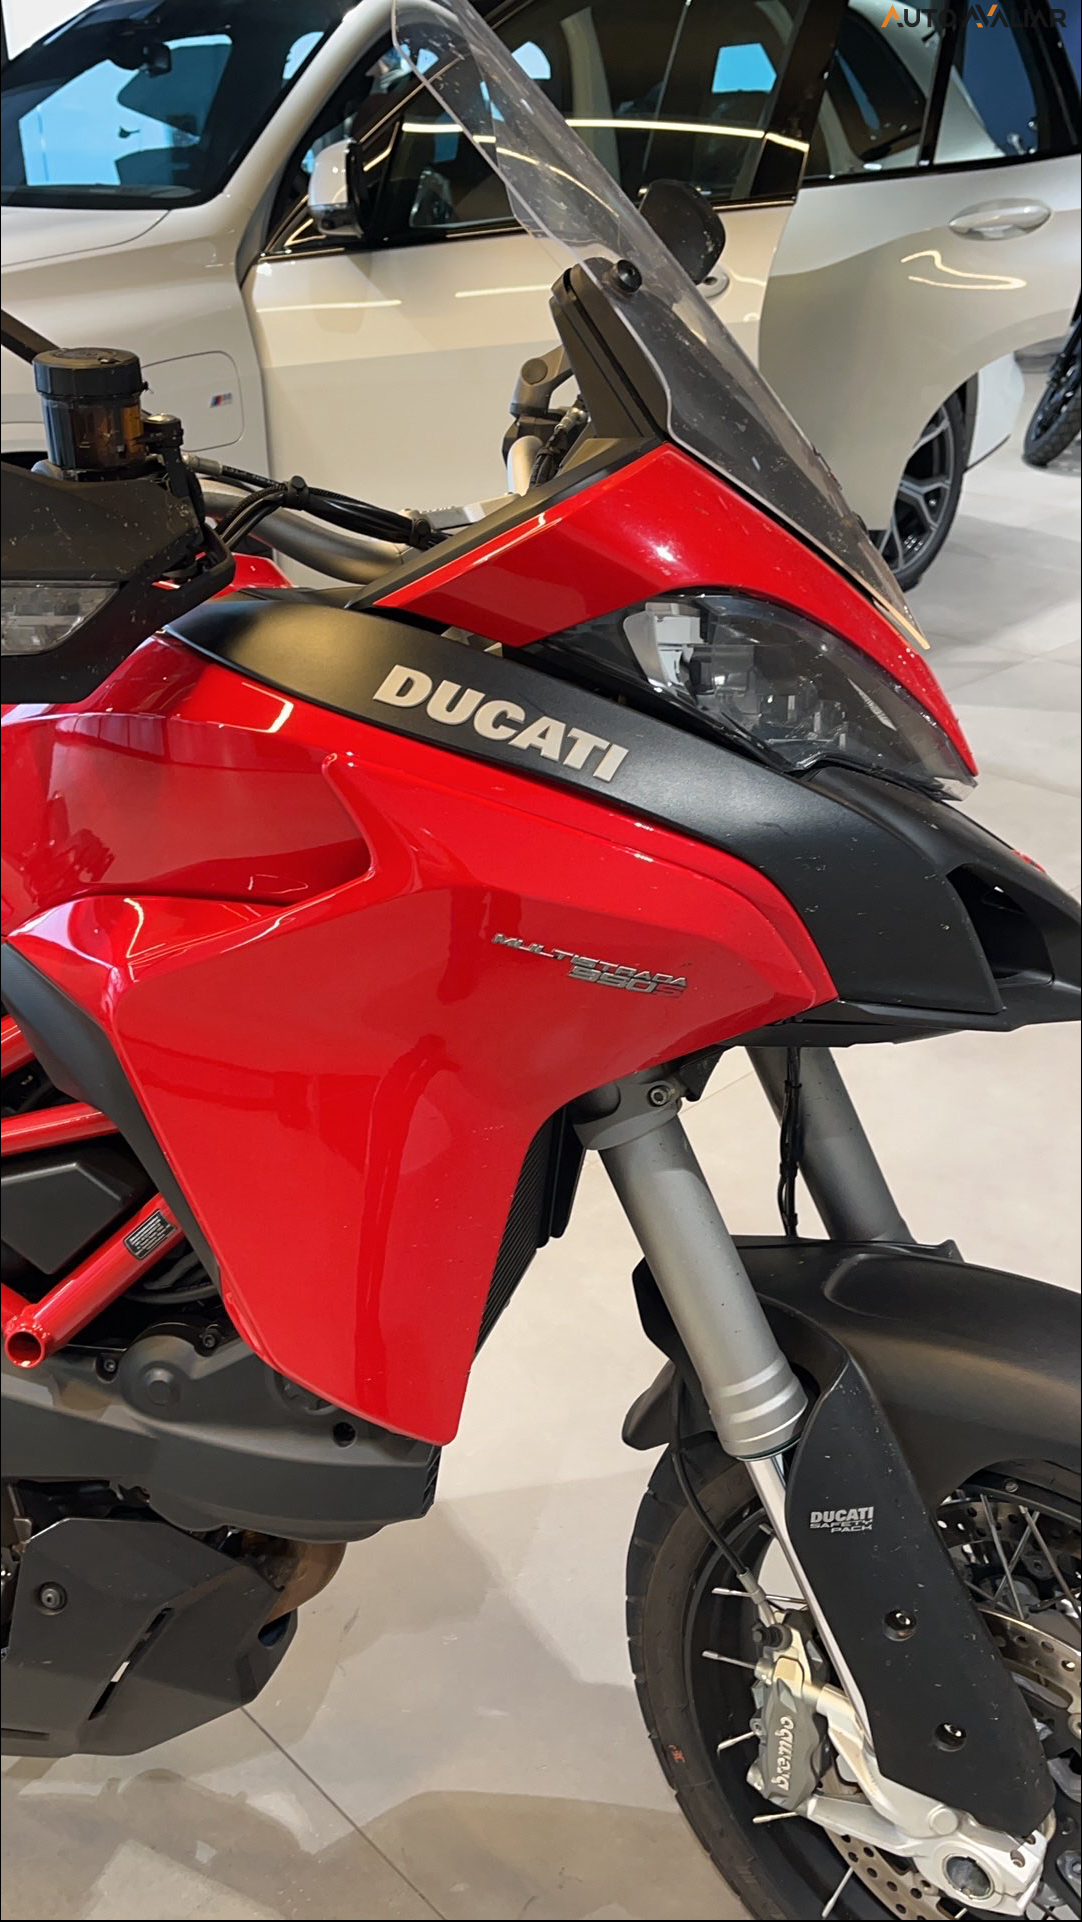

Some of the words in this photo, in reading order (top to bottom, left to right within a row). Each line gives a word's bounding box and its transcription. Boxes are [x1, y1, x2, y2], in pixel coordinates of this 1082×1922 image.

[373, 664, 629, 783] DUCATI
[492, 933, 687, 986] MULTISTRADA
[810, 1506, 874, 1523] DUCATI
[810, 1519, 873, 1528] SAFETY
[831, 1525, 873, 1533] PACK
[771, 1716, 794, 1791] brembo
